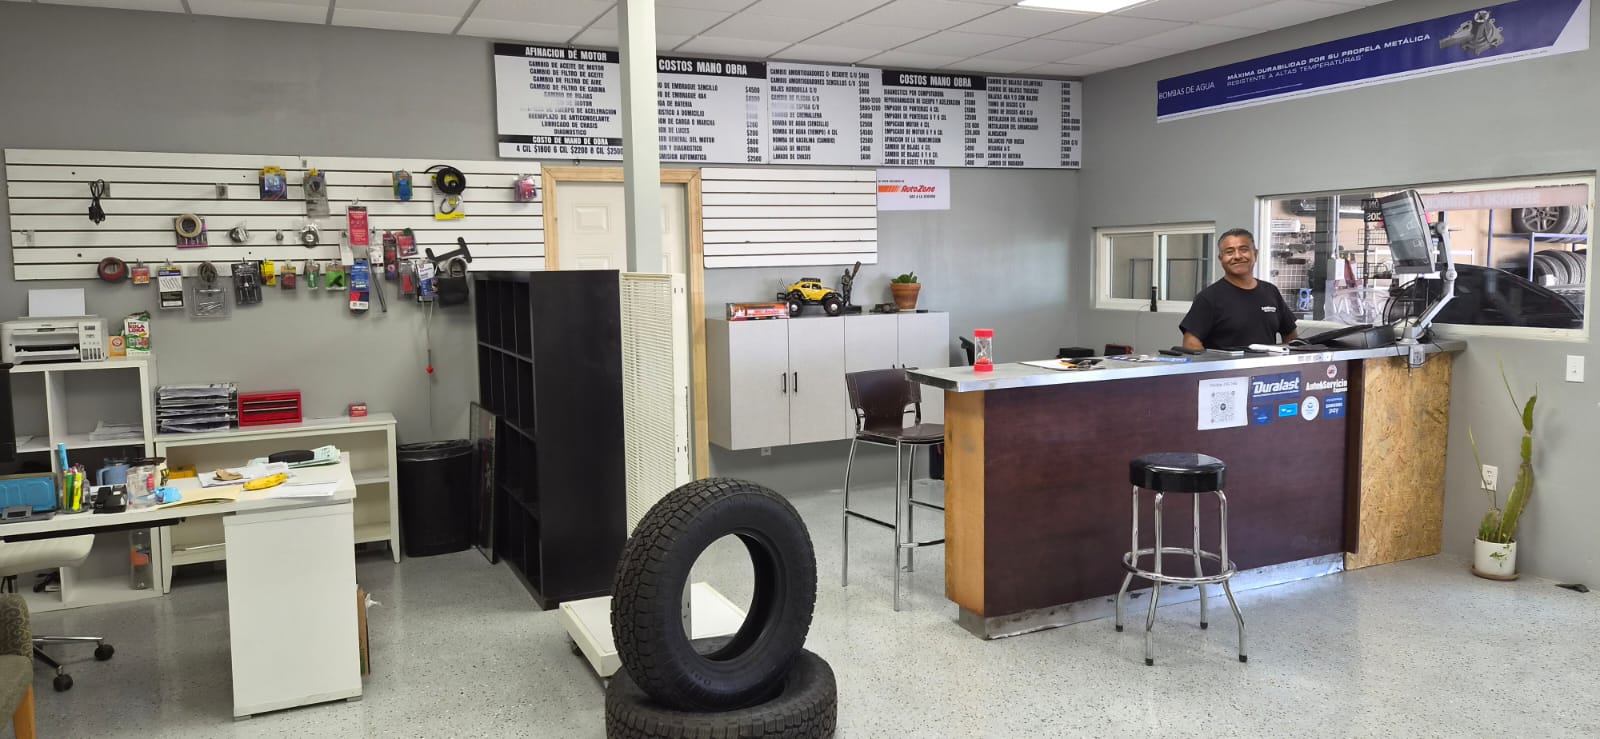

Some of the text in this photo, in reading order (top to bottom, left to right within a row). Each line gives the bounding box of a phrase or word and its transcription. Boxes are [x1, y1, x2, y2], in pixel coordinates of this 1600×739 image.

[525, 47, 607, 61] AFINACION DE MOTOR
[1227, 70, 1255, 80] MÁXIMA
[1257, 60, 1306, 74] DURABILIDAD
[1308, 56, 1325, 64] POR
[1341, 45, 1381, 57] PROPELA
[1384, 34, 1431, 48] METÁLICA
[659, 59, 747, 75] COSTOS MANO OBRA
[900, 74, 972, 87] COSTOS MANO OBRA
[1227, 74, 1266, 86] RESISTENTE
[1158, 81, 1215, 100] BOMBAS DE AGUA
[1252, 377, 1300, 394] Duralast
